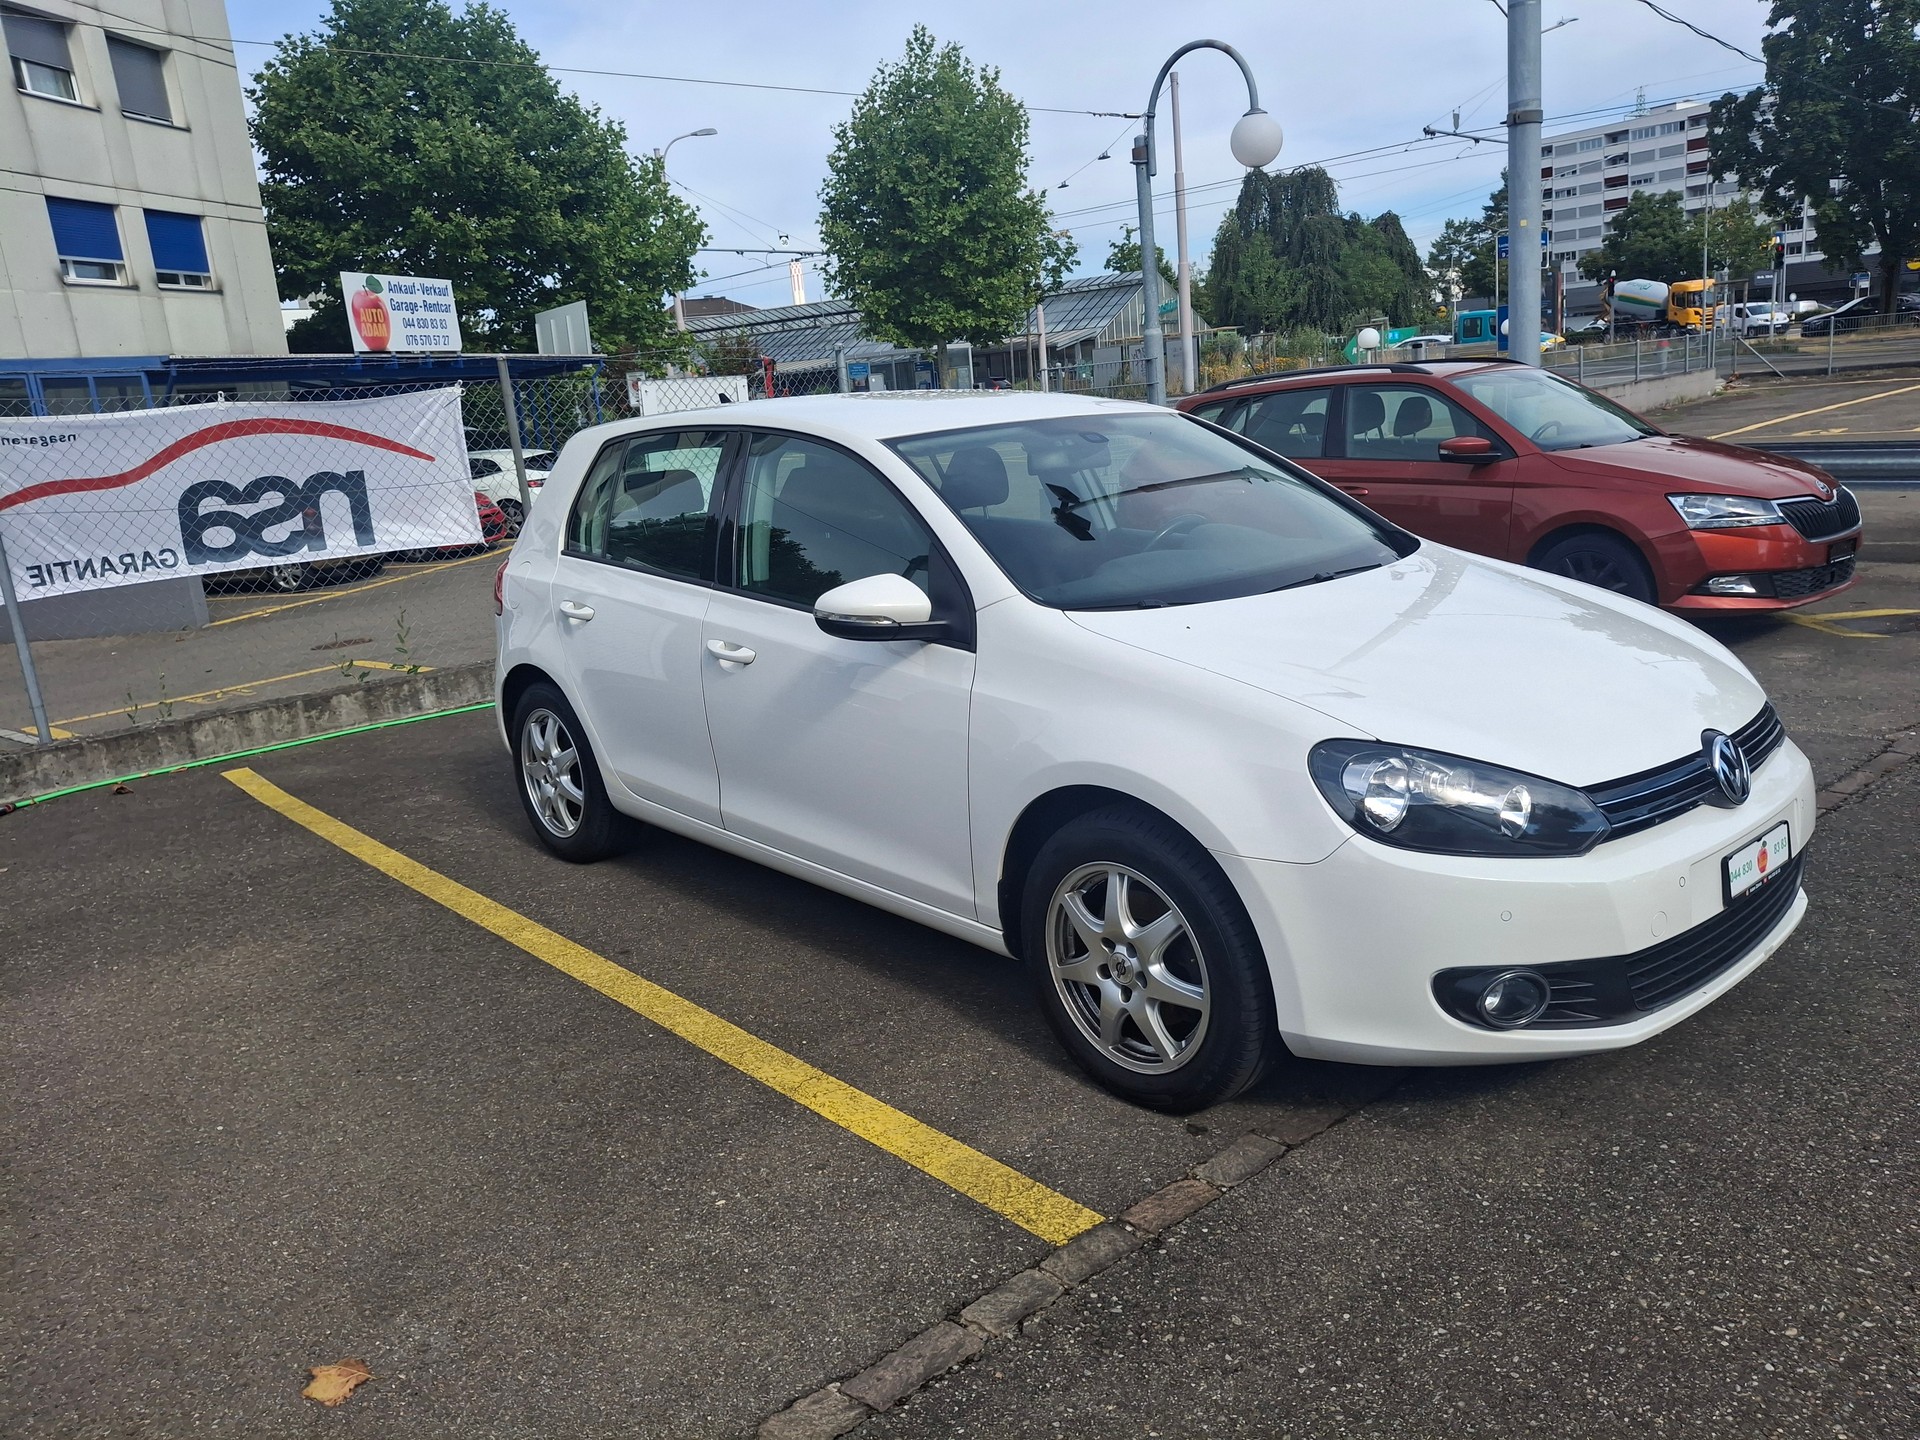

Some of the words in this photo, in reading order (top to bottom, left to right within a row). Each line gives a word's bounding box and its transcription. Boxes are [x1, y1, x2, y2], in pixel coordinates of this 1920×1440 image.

[360, 308, 384, 323] AUTO
[361, 323, 388, 337] ADAM
[402, 317, 415, 329] 044
[416, 318, 430, 329] 830
[430, 318, 438, 330] 83
[439, 319, 448, 330] 83
[405, 335, 419, 346] 076
[419, 335, 433, 346] 570
[433, 335, 441, 346] 57
[442, 335, 450, 346] 27
[1742, 860, 1753, 876] 830
[1773, 841, 1780, 854] 83
[1781, 836, 1787, 849] 83
